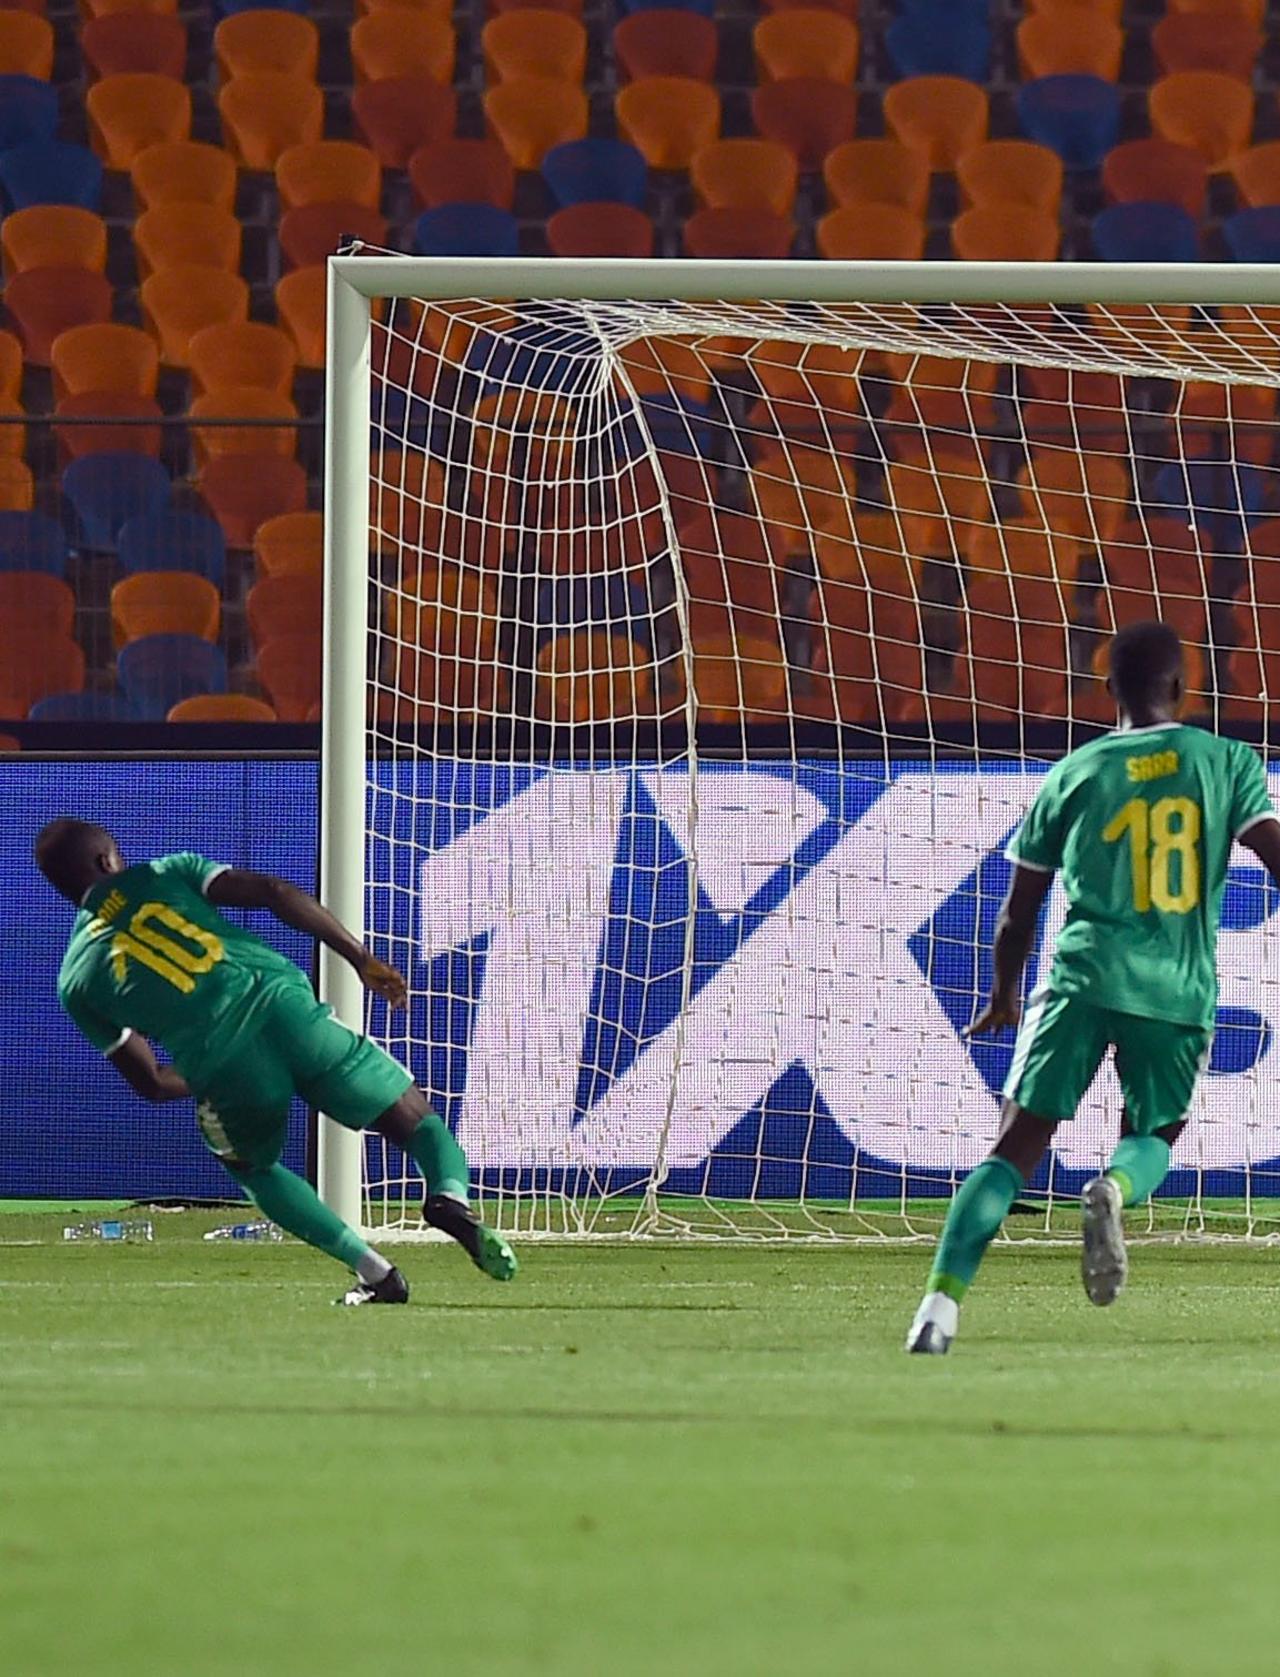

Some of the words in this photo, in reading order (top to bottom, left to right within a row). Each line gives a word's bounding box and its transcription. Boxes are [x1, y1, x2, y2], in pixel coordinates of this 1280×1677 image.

[1126, 750, 1179, 783] SARR
[1103, 796, 1200, 914] 18
[110, 902, 225, 994] 10
